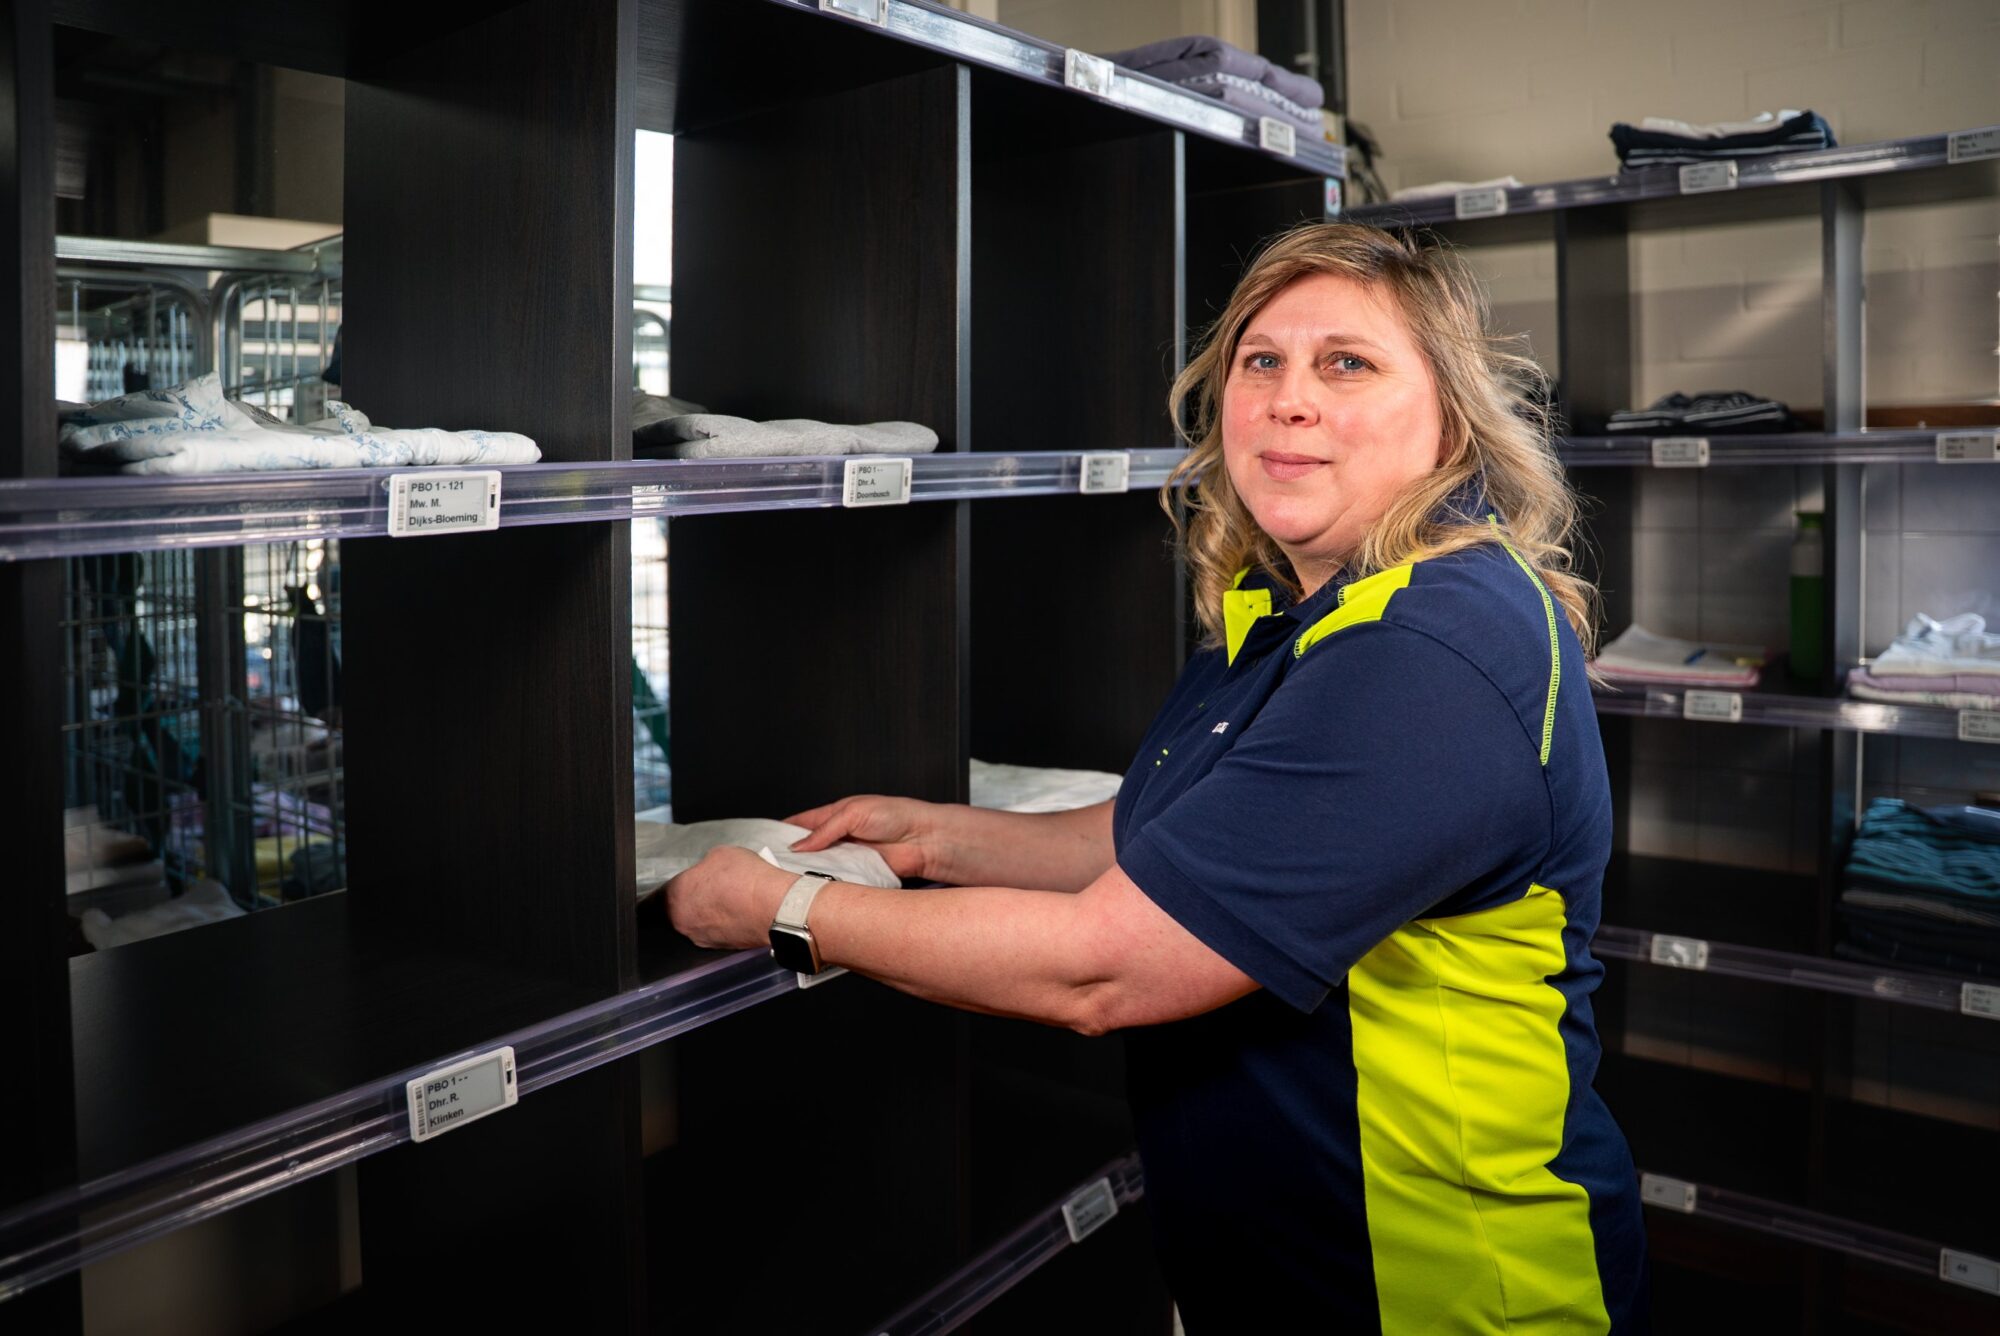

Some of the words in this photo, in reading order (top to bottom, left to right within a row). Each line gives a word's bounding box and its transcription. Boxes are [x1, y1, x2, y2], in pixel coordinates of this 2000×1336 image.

[859, 466, 872, 474] PBO
[411, 482, 433, 492] PBO
[435, 482, 440, 491] 1
[449, 481, 464, 490] 121
[410, 500, 428, 509] Mw.
[431, 499, 441, 507] M.
[427, 1080, 449, 1095] PBO
[451, 1077, 456, 1086] 1
[429, 1098, 449, 1111] Dhr.
[450, 1092, 460, 1103] R.
[429, 1108, 464, 1128] Klinken
